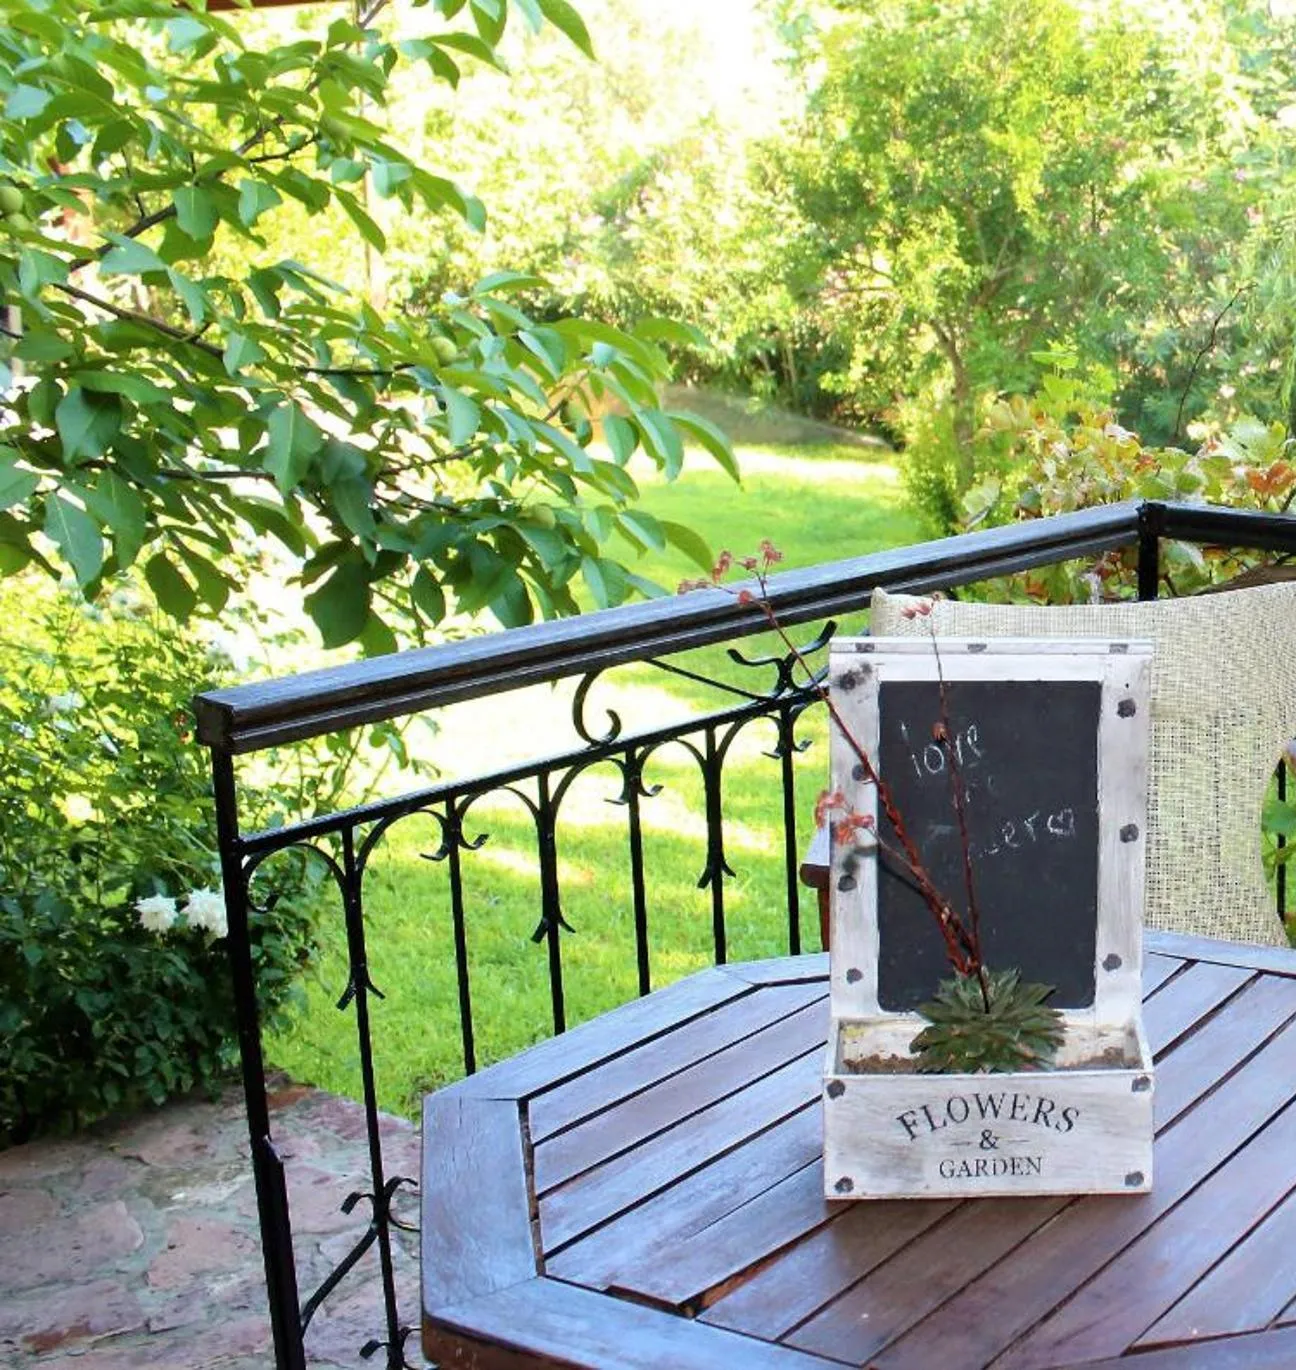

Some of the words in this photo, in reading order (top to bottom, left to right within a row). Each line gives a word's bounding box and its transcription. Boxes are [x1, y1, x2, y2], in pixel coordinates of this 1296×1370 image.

[895, 1092, 1080, 1141] FLOWERS
[978, 1129, 999, 1150] &
[938, 1156, 1043, 1180] GARDEN
